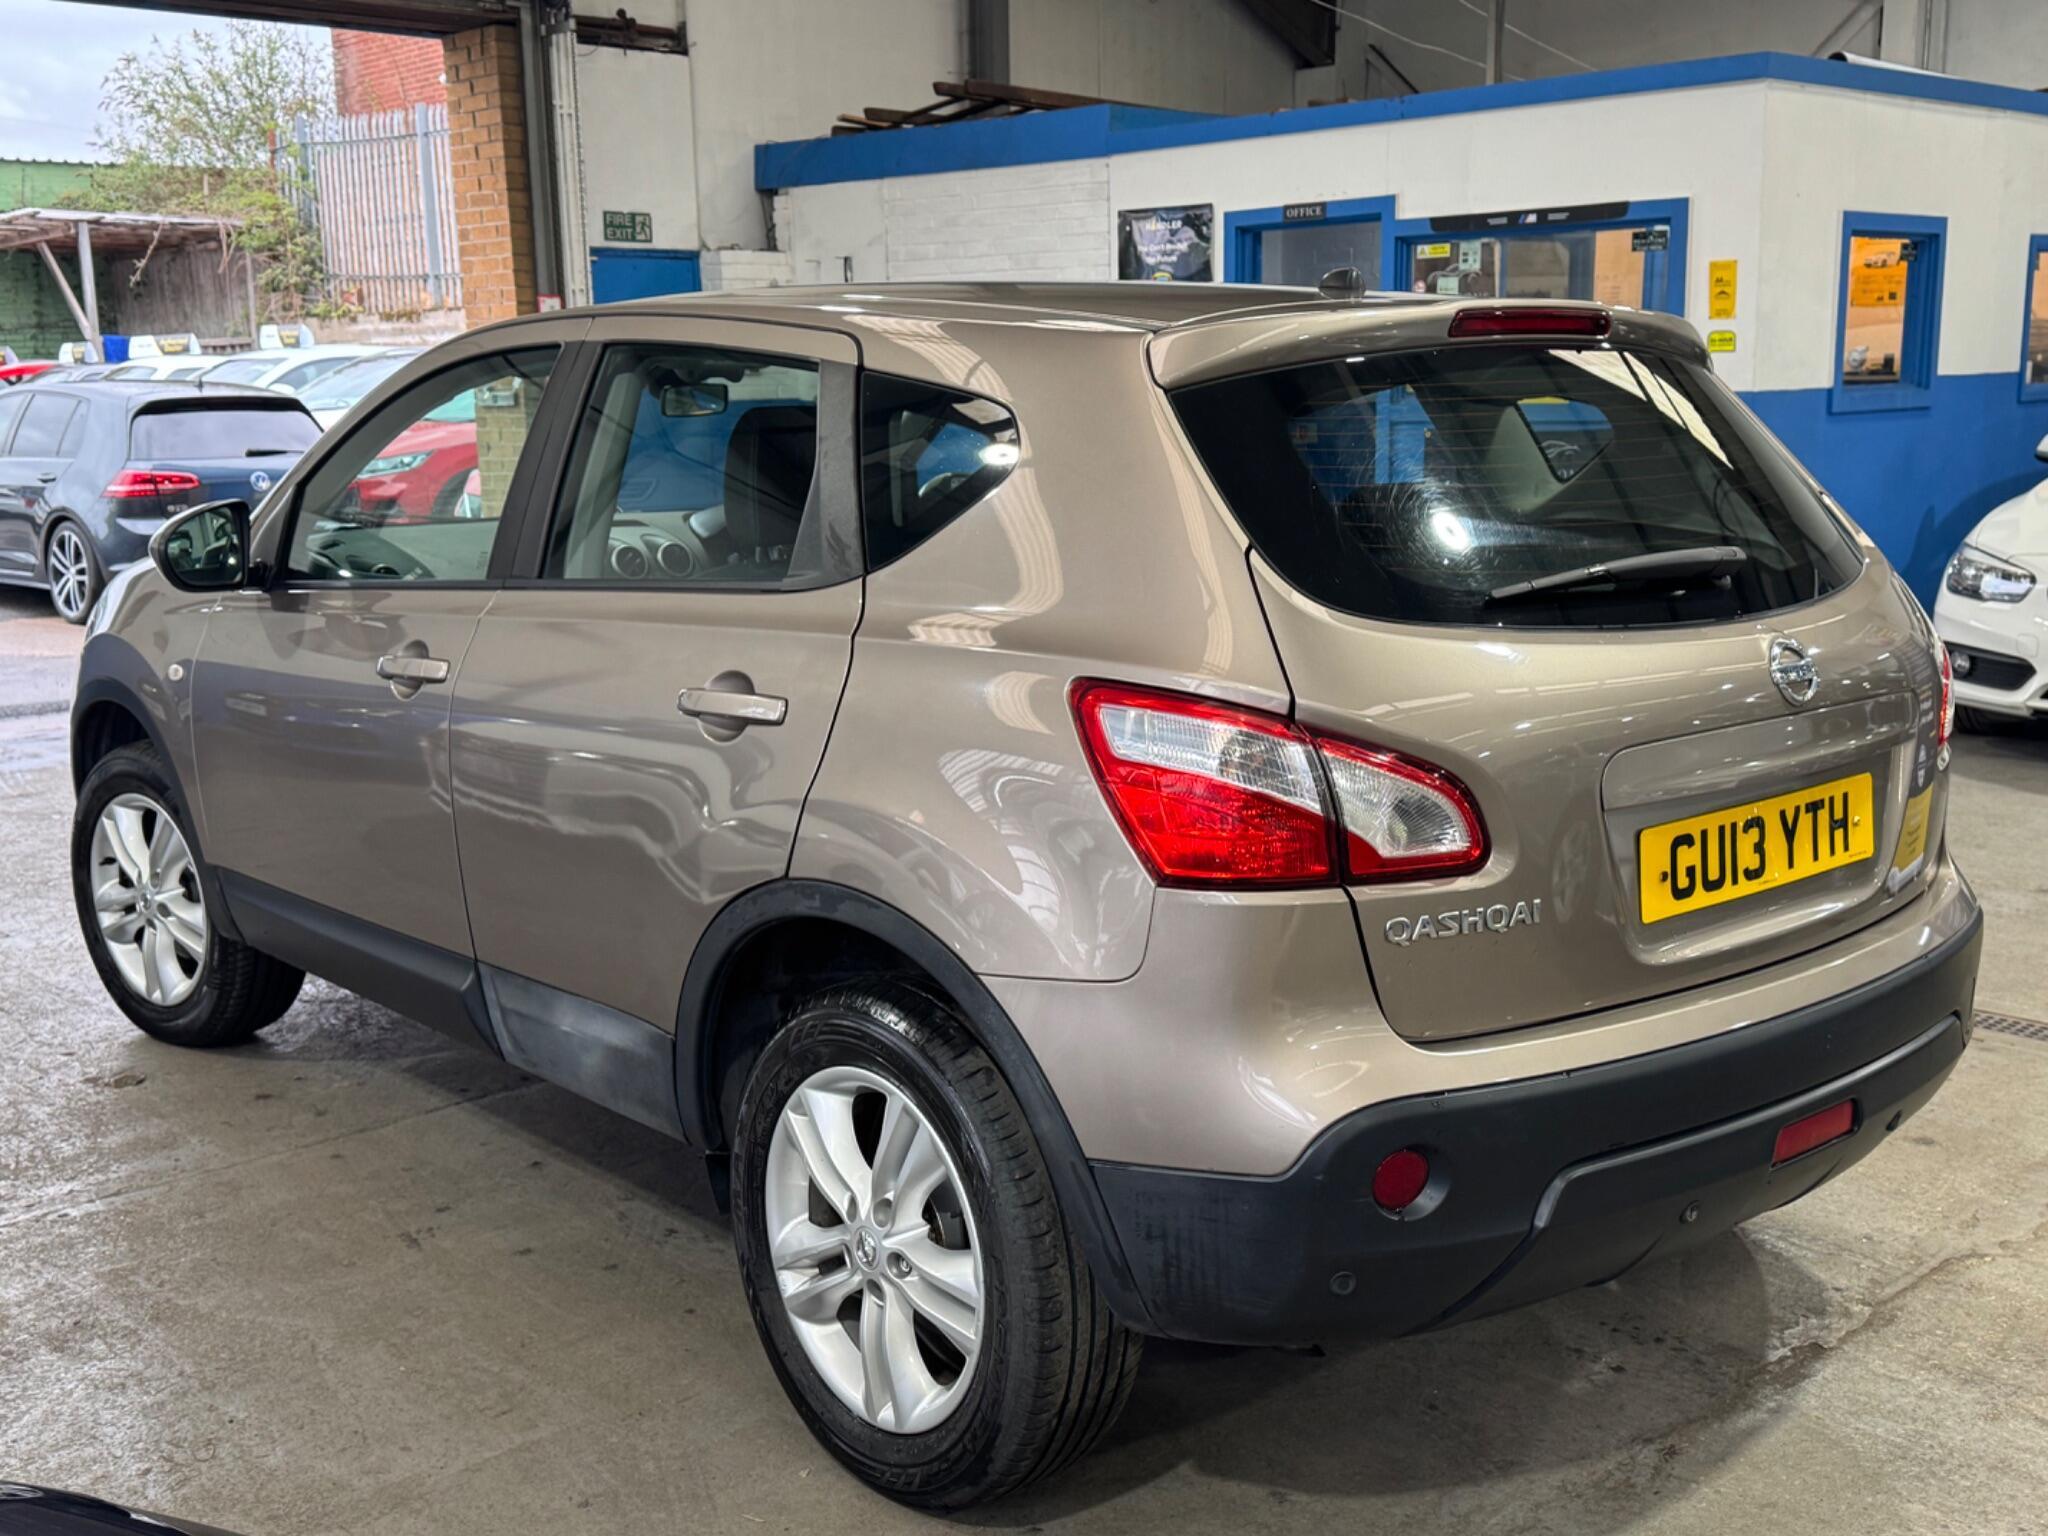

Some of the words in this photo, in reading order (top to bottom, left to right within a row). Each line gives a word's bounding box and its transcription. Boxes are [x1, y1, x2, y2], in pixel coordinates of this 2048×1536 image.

[1286, 205, 1322, 218] OFFICE
[606, 213, 633, 226] FIRE
[606, 227, 633, 240] EXIT
[1670, 815, 1766, 901] GU13
[1779, 791, 1850, 871] YTH
[1385, 898, 1542, 947] QASHQAI
